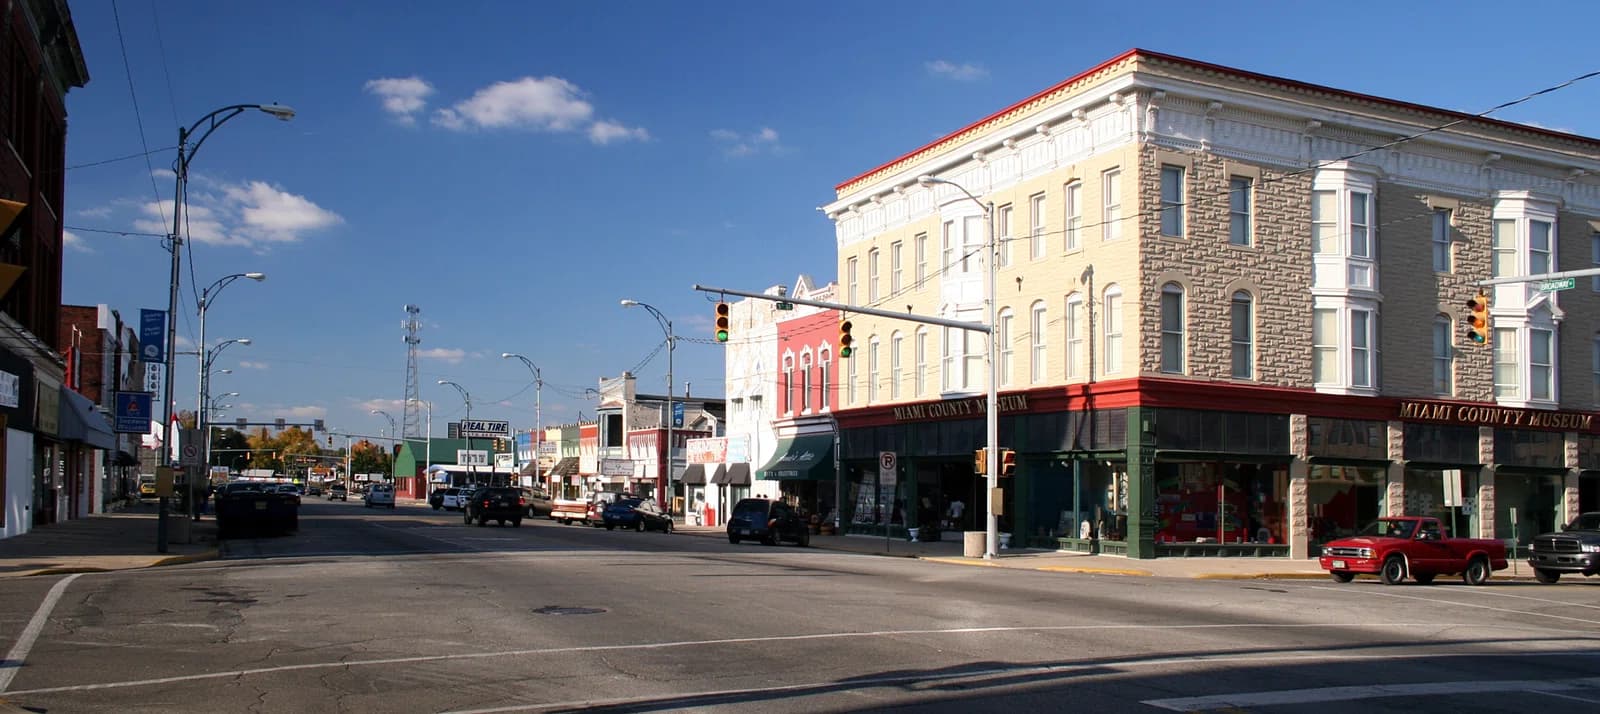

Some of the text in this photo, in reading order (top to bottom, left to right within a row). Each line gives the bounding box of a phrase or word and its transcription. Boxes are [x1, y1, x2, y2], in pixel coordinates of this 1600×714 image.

[1541, 281, 1569, 290] BROADWAY
[893, 394, 1028, 420] MIAMI COUNTY MSEUM
[1399, 402, 1592, 430] MIAMI COUNTY MUSEUM
[463, 421, 507, 432] REAL TIRE
